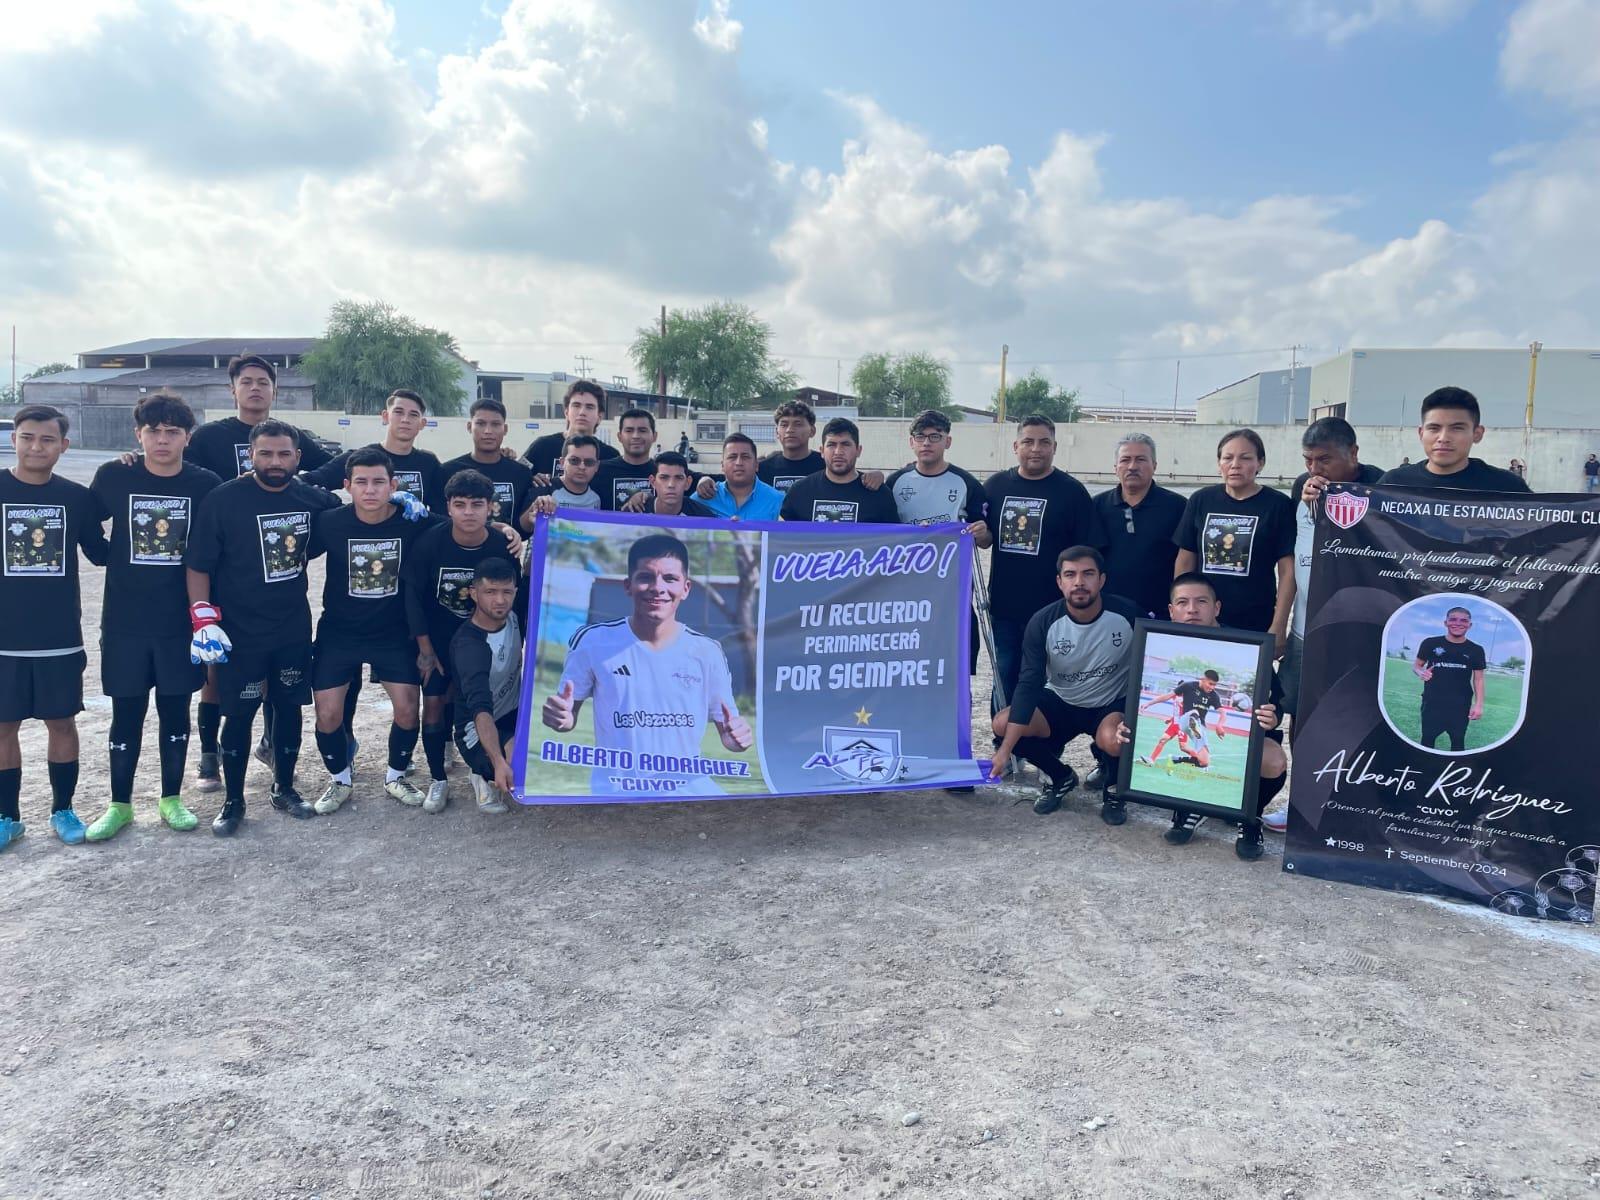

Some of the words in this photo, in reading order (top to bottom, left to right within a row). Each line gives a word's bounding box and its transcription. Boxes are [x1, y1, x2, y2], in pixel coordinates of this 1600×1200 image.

[1380, 501, 1430, 516] NECAXA
[1434, 503, 1450, 517] DE
[1453, 505, 1524, 521] ESTANCIAS
[1527, 506, 1577, 524] FÚTBOL
[772, 548, 865, 583] VUELA
[1320, 539, 1397, 559] Lamentamos
[1399, 550, 1498, 567] profundamente
[1502, 556, 1517, 568] el
[1378, 568, 1422, 581] nuestro
[1427, 574, 1468, 589] amigo
[1468, 578, 1482, 591] y
[1479, 577, 1544, 593] jugador
[799, 604, 824, 628] TU
[828, 600, 932, 626] RECUERDO
[804, 629, 920, 654] PERMANECERÁ
[775, 664, 822, 691] POR
[828, 660, 930, 689] SIEMPRE
[613, 710, 635, 728] Las
[541, 740, 633, 770] ALBERTO
[639, 752, 750, 778] RODRÍGUEZ
[1312, 749, 1423, 796] Alberto
[610, 776, 688, 792] "CUYO"
[1367, 807, 1382, 816] al
[1379, 810, 1411, 821] padre
[1412, 816, 1459, 828] celestial
[1455, 821, 1482, 833] para
[1486, 827, 1508, 838] que
[1509, 831, 1556, 845] consuele
[1385, 822, 1441, 840] familiares
[1441, 834, 1451, 845] y
[1452, 835, 1497, 849] amigos!
[1337, 839, 1365, 852] 1998
[1400, 850, 1507, 877] Septiembre/2024
